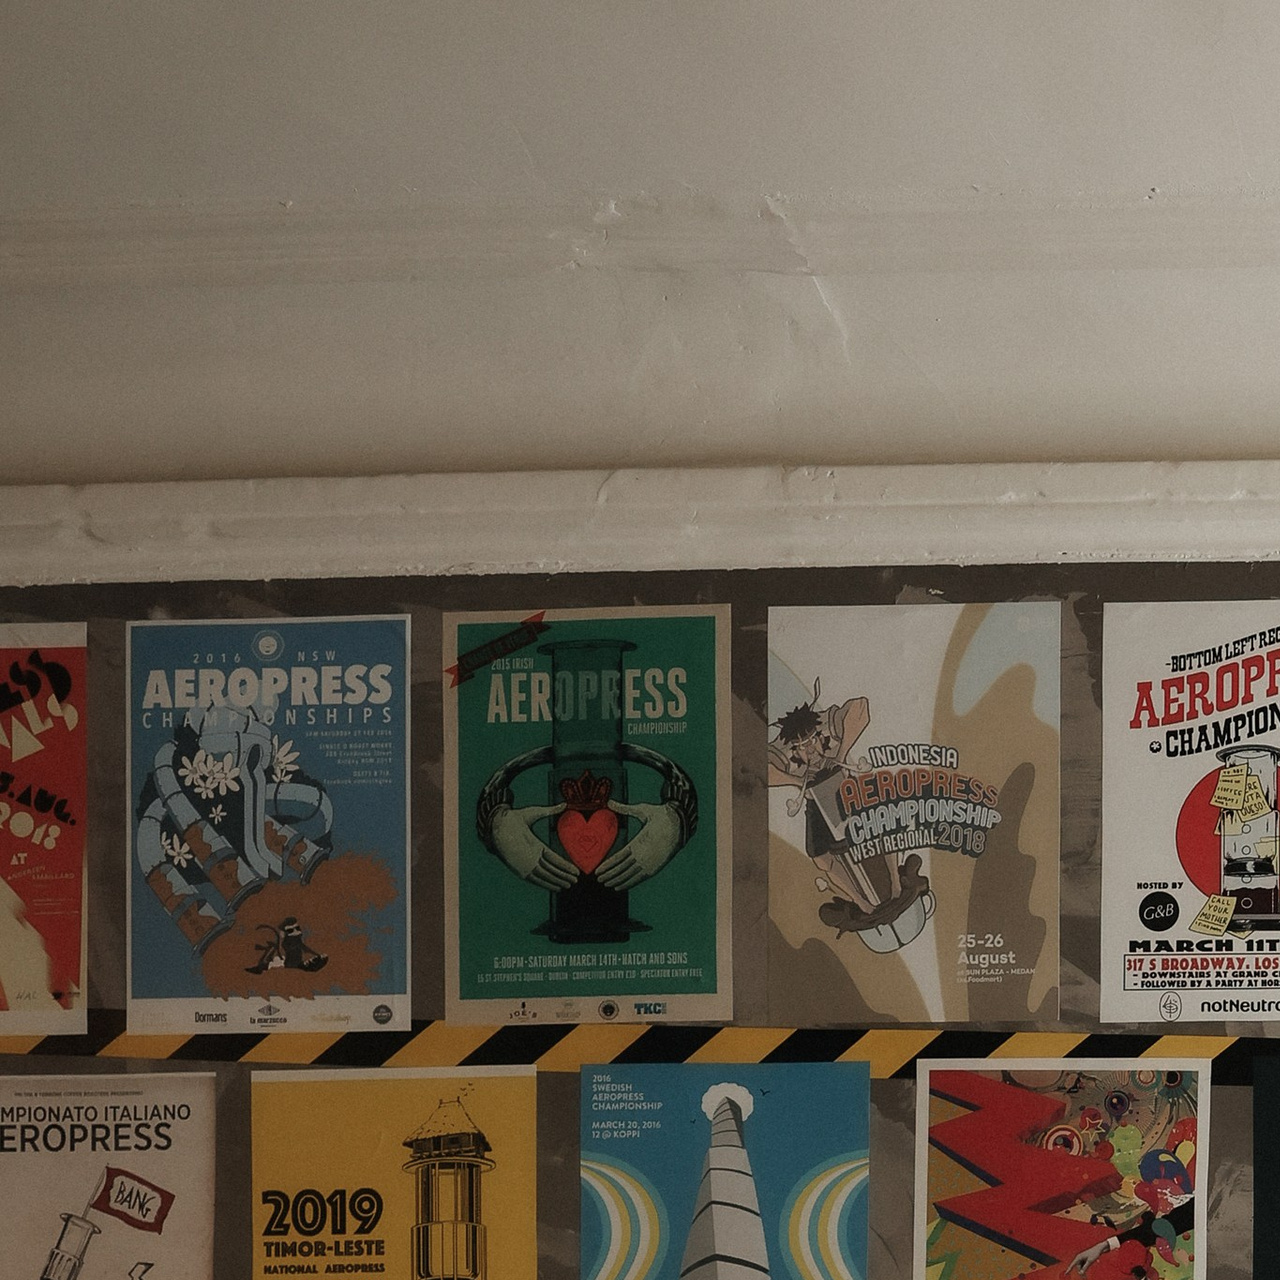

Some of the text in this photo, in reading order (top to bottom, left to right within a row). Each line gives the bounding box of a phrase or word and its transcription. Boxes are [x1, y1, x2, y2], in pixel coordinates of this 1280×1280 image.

[1225, 635, 1256, 660] LEFT
[193, 650, 336, 663] 2016 NSW
[491, 658, 534, 671] 2015 IRISH
[142, 663, 392, 709] AEROPRESS
[487, 667, 687, 723] AEROPRESS
[628, 722, 687, 735] CHAMPIONSHIP
[869, 745, 958, 769] INDONESIA
[841, 769, 998, 814] AEROPRESS
[849, 799, 1001, 844] CHAMPIONSHIP
[851, 839, 880, 862] WEST
[938, 822, 985, 853] 2018
[1144, 902, 1174, 920] G&B
[958, 934, 1003, 948] 25-26
[1129, 940, 1233, 952] MARCH
[958, 951, 1016, 967] August
[1127, 958, 1144, 970] 317
[1255, 958, 1279, 970] LOS
[634, 1003, 662, 1014] TKC
[592, 1093, 644, 1101] AEROPRESS
[105, 1104, 190, 1121] ITALIANO
[592, 1102, 663, 1110] CHAMPIONSHIP
[114, 1181, 155, 1218] BANG
[262, 1188, 383, 1236] 2019
[264, 1240, 385, 1257] TIMOR-LESTE
[264, 1264, 385, 1274] NATIONAL AEROPRESS
